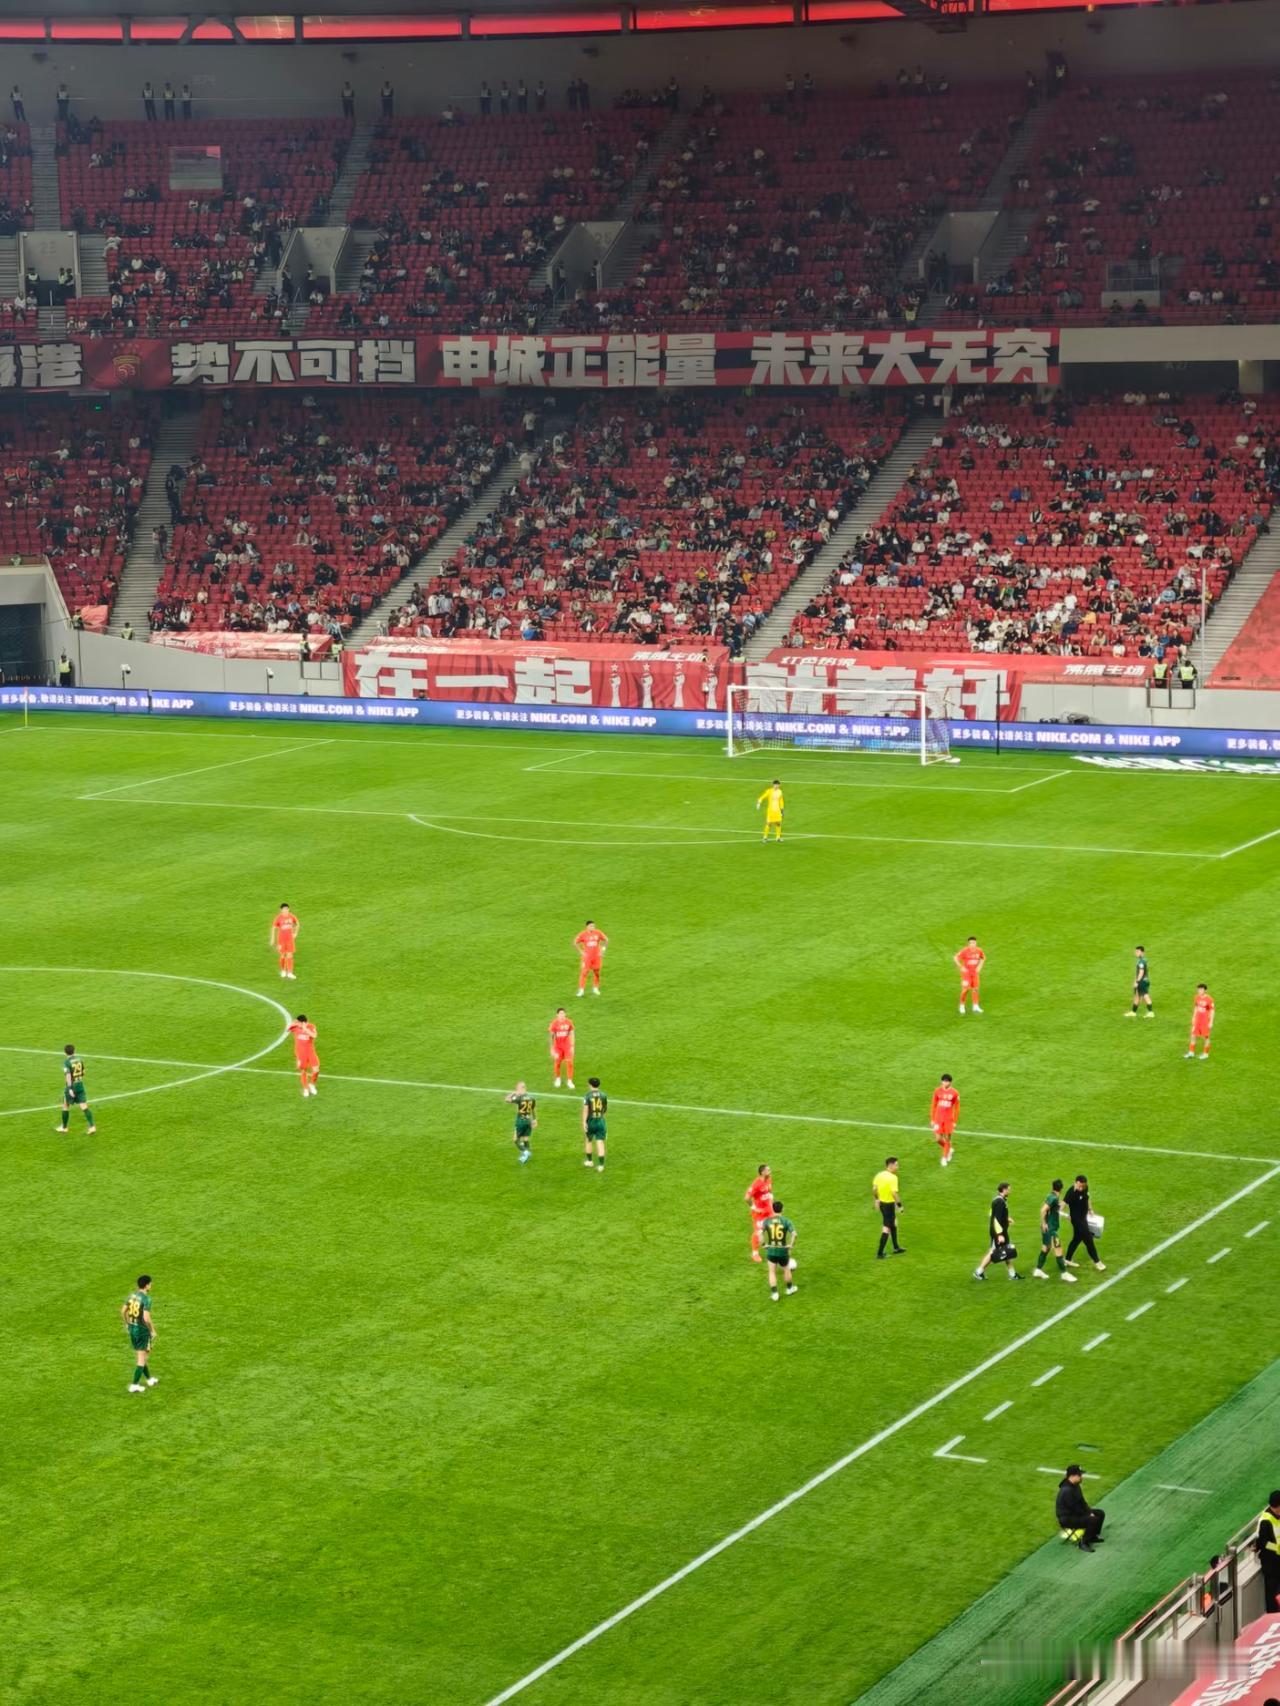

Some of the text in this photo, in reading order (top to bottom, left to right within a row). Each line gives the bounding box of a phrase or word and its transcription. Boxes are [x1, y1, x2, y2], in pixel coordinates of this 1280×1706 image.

[171, 340, 416, 385] 势不可挡
[443, 328, 1052, 387] 申城正能量 未来大无穷
[354, 650, 592, 705] 在一起
[129, 697, 138, 707] &
[172, 698, 194, 709] APP
[299, 703, 353, 715] NIKE.COM
[356, 705, 365, 716] &
[367, 706, 394, 717] NIKE
[396, 706, 419, 718] APP
[530, 712, 587, 724] NIKE.COM
[590, 714, 600, 725] &
[602, 715, 630, 726] NIKE
[632, 716, 657, 728] APP
[775, 722, 836, 734] NIKE.COM
[839, 724, 849, 735] &
[852, 725, 881, 736] NIKE
[1036, 731, 1102, 744] NIKE.COM
[1104, 734, 1116, 745] &
[1119, 734, 1151, 746] NIKE
[1153, 736, 1181, 747] APP
[769, 1224, 784, 1240] 16
